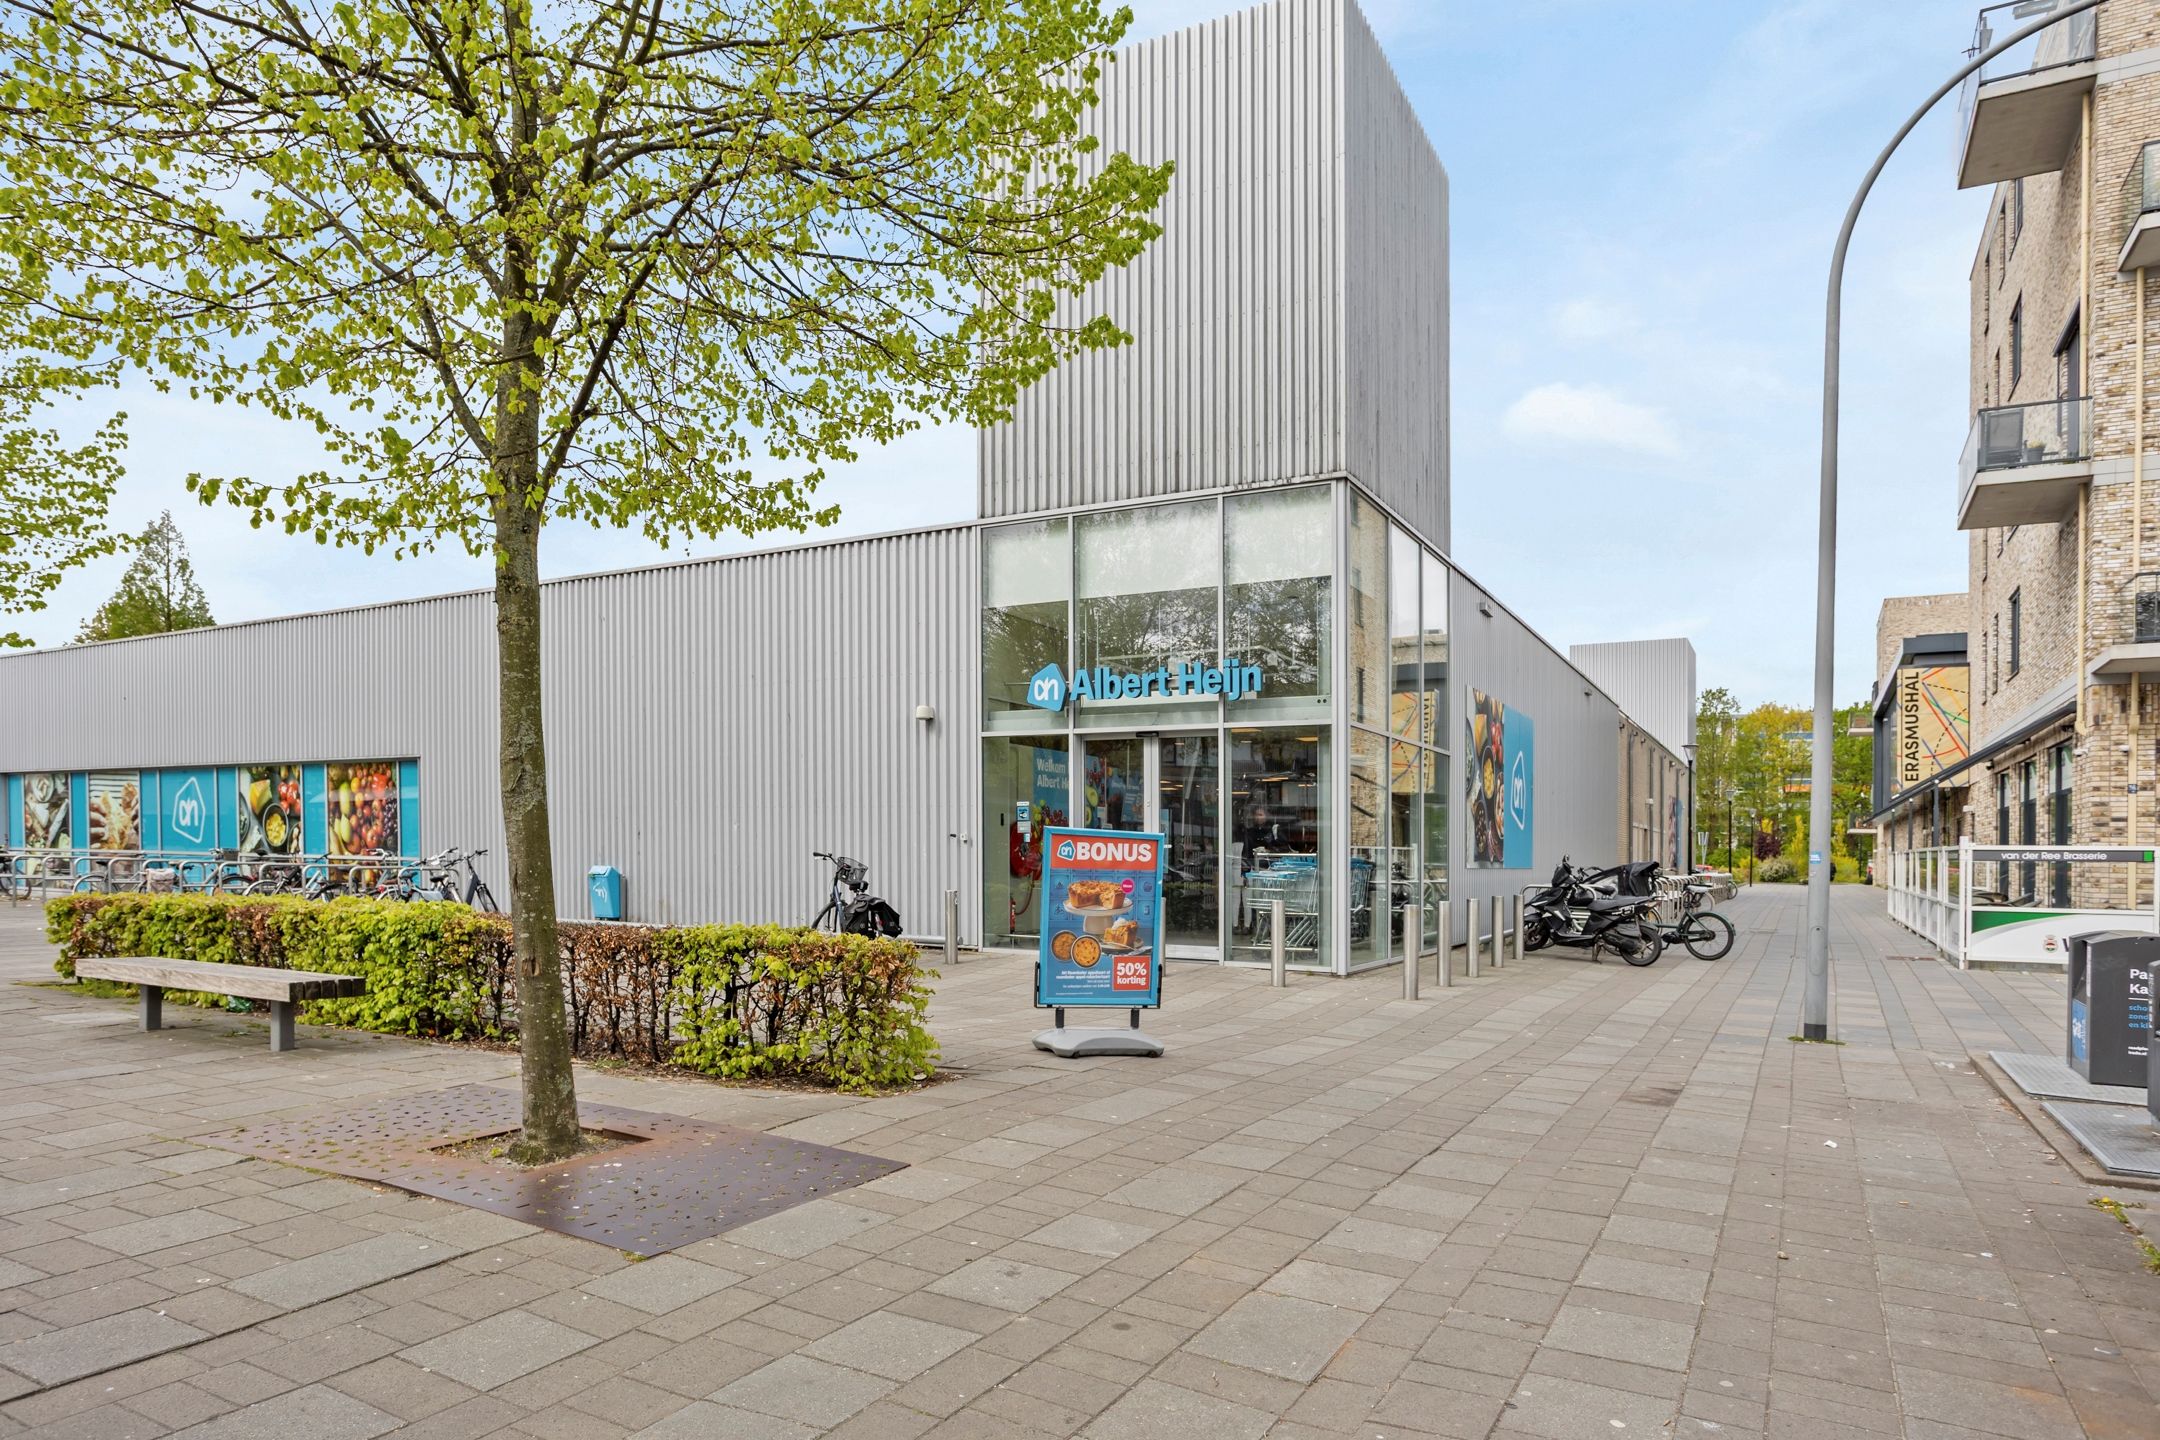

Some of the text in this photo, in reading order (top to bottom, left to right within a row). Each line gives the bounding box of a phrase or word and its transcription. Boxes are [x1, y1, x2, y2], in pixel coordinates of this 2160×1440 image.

[1070, 658, 1263, 701] Albert Heijn
[1904, 671, 1919, 782] ERASMUSHAL
[1036, 758, 1066, 773] Welkom
[1036, 774, 1060, 789] Albert
[1076, 842, 1152, 862] BONUS
[2001, 851, 2108, 860] van der Ree Brasserie
[1116, 962, 1147, 976] 50%
[2129, 968, 2149, 980] Pa
[1116, 976, 1147, 985] korting
[2129, 983, 2149, 995] Ka
[2128, 1004, 2148, 1012] scho
